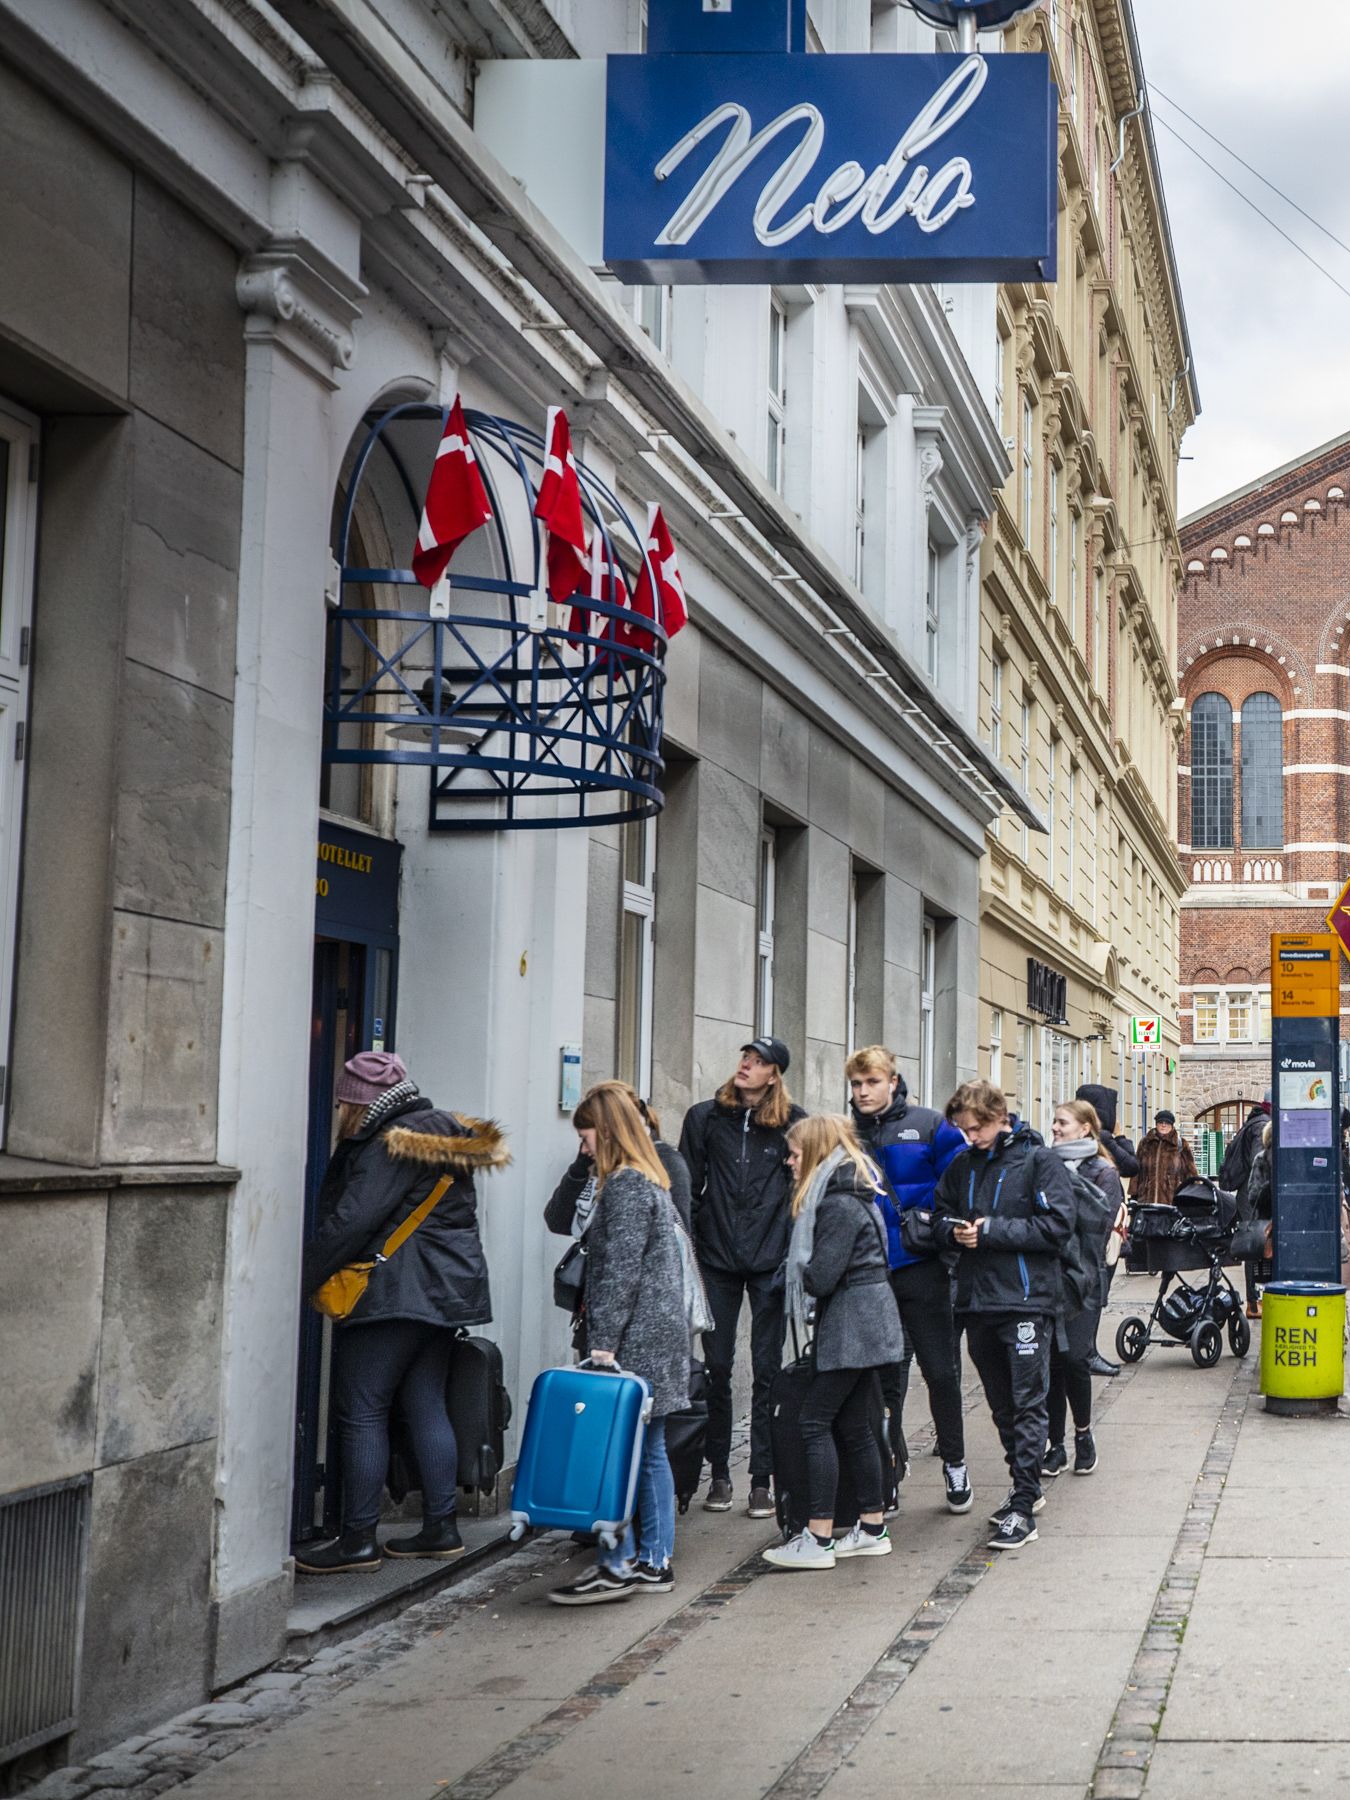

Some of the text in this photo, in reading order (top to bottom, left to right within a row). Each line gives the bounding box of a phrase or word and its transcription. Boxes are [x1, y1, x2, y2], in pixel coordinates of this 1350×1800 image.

[653, 52, 988, 248] Nebo
[519, 949, 528, 977] 6
[1281, 962, 1294, 972] 10
[1281, 990, 1294, 1000] 14
[1139, 1021, 1154, 1042] 7
[1291, 1059, 1316, 1069] movia
[1275, 1327, 1317, 1344] REN
[1275, 1350, 1317, 1367] KBH
